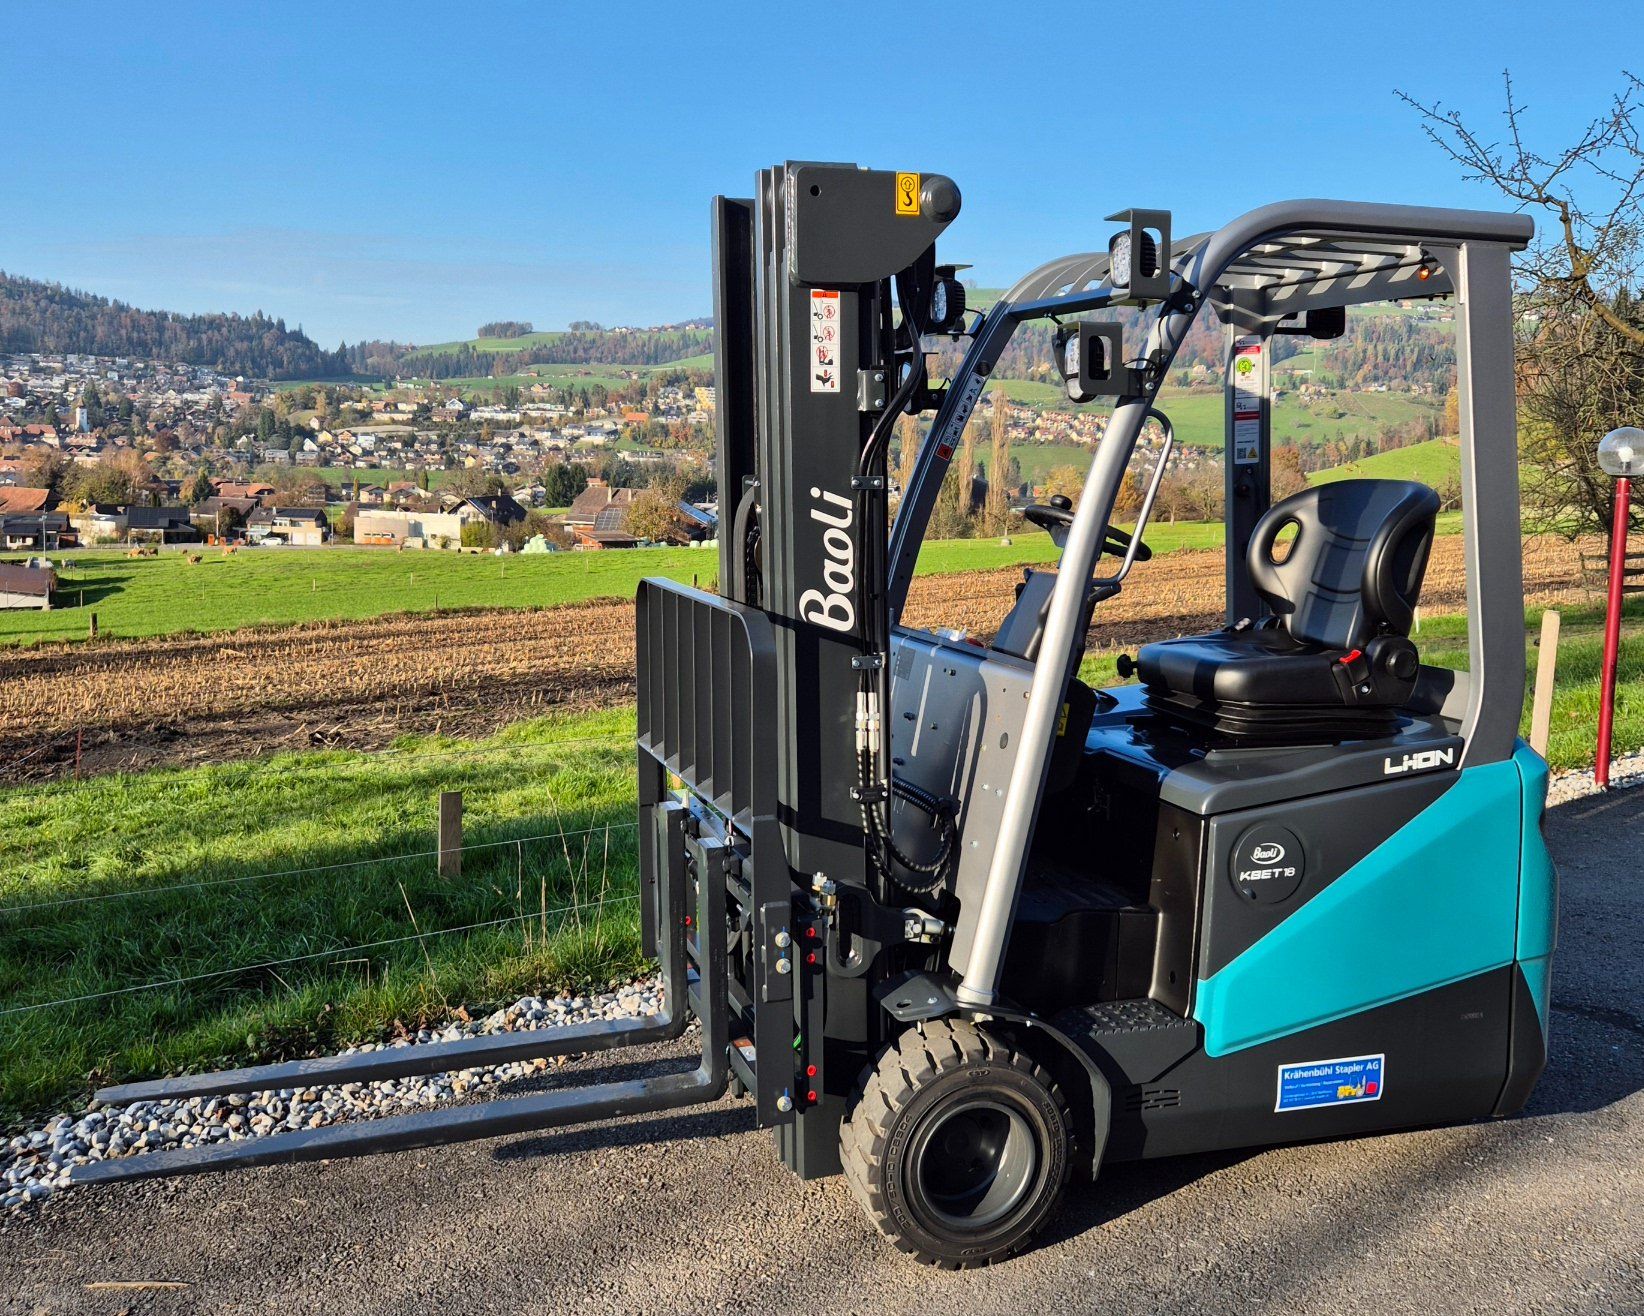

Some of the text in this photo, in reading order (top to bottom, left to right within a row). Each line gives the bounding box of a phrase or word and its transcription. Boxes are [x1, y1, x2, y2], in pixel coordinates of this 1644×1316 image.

[798, 486, 855, 632] Baoli
[1284, 1061, 1379, 1080] Krähenbühl Stapler AG
